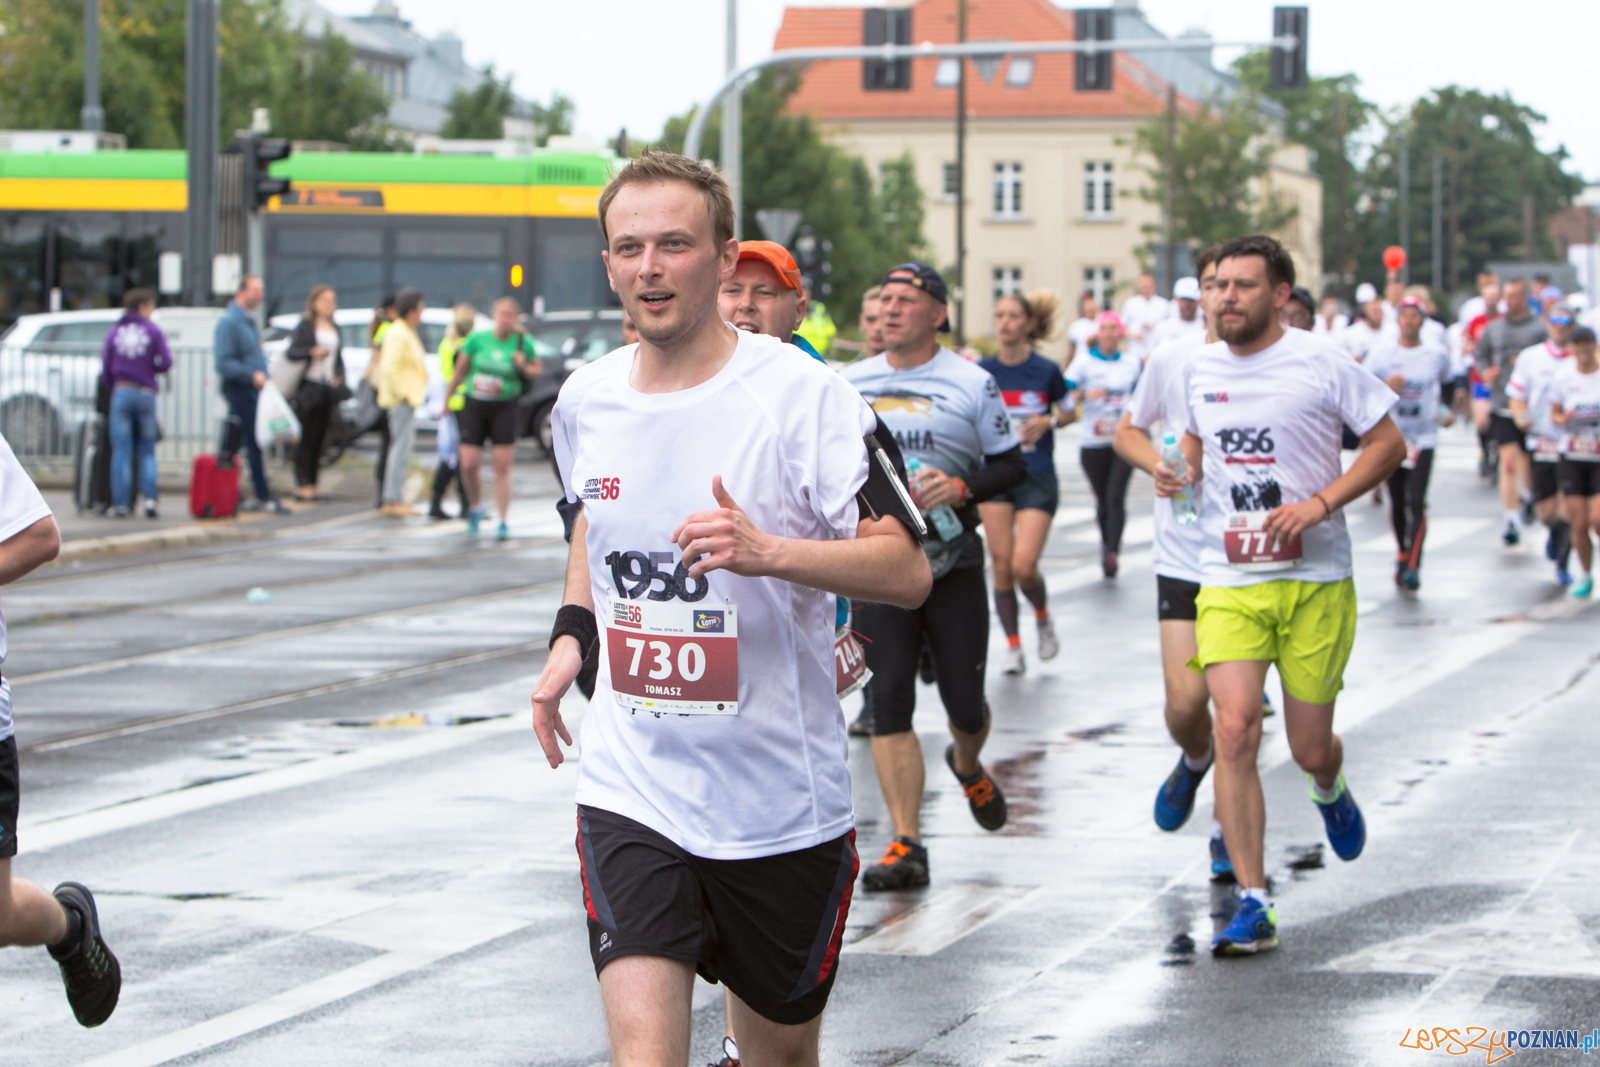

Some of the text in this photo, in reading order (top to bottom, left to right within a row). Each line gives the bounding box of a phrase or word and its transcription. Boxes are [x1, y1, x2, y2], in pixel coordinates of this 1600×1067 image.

[889, 429, 935, 450] AHA
[1215, 427, 1275, 454] 1956
[604, 550, 709, 603] 1956
[700, 618, 717, 627] LOTTO
[625, 637, 707, 682] 730
[644, 684, 682, 696] TOMASZ
